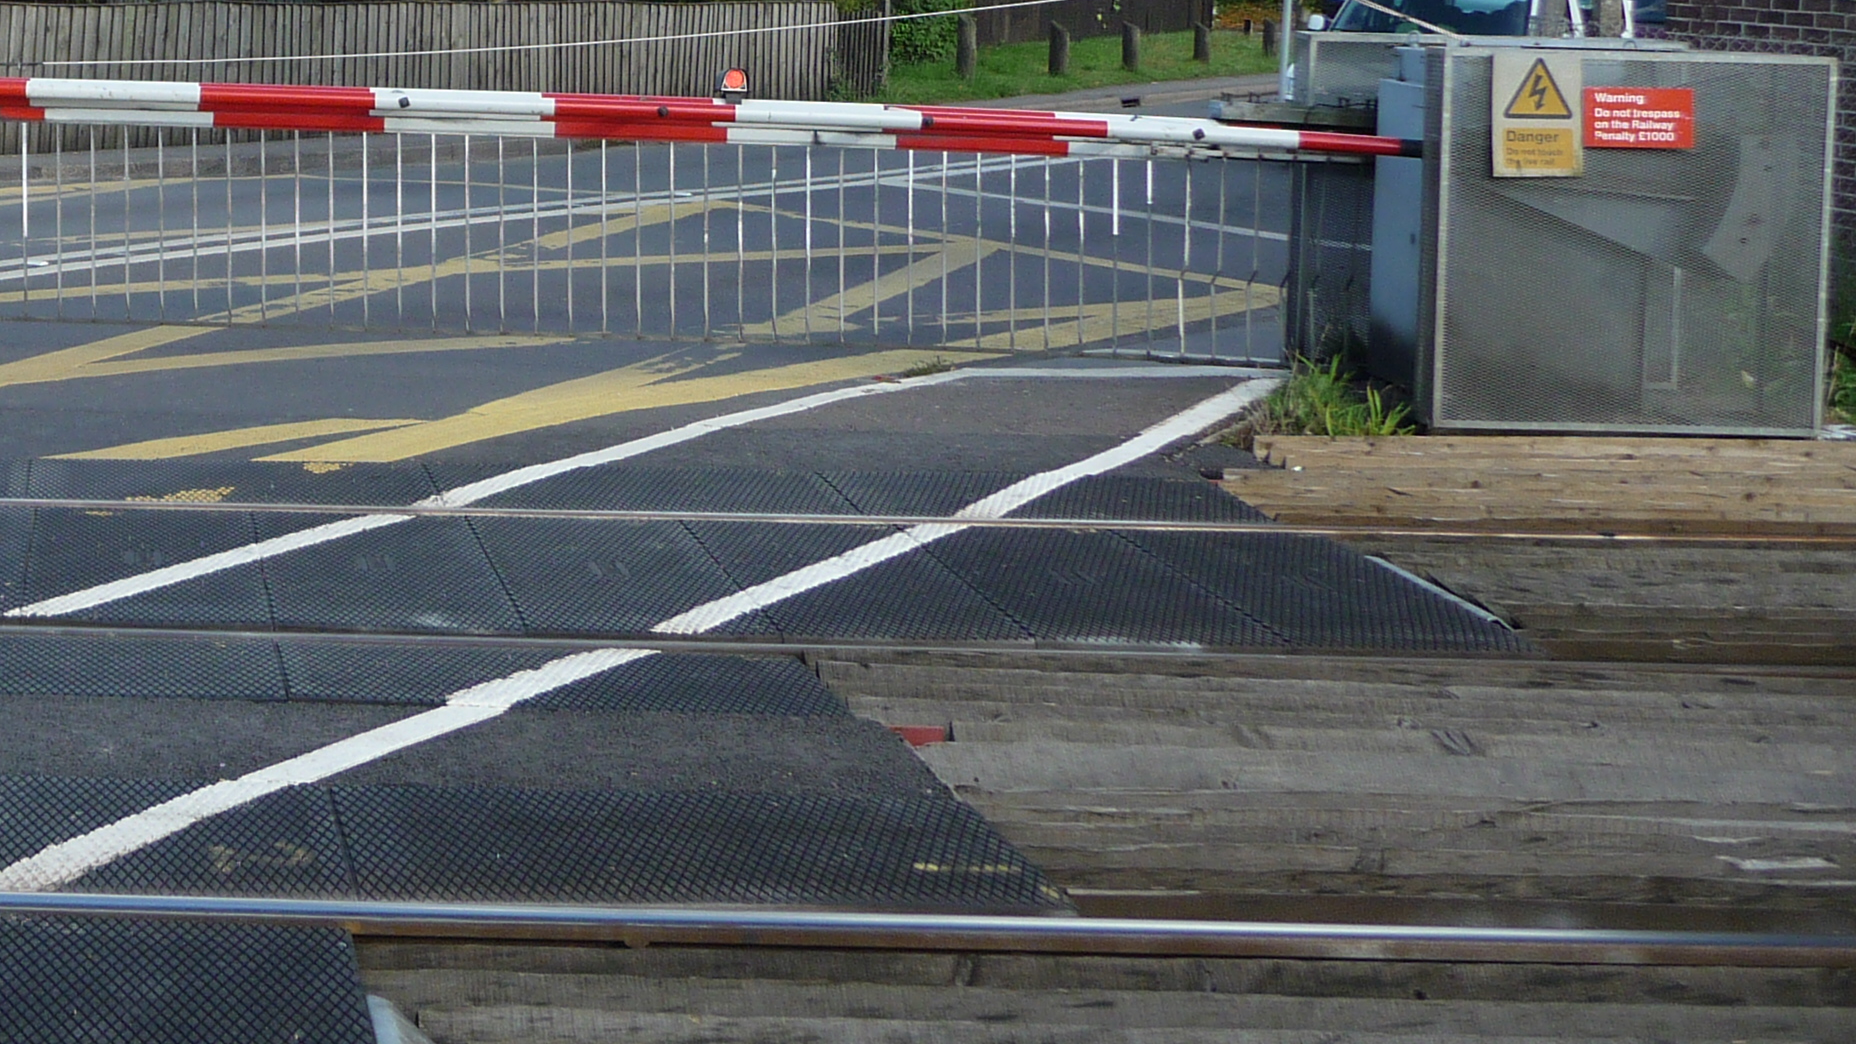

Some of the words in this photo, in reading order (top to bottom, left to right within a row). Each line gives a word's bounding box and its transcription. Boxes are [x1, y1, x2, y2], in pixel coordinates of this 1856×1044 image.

[1594, 92, 1645, 105] Warning
[1594, 107, 1611, 118] Do
[1612, 108, 1631, 118] not
[1633, 108, 1681, 120] trespass
[1594, 121, 1609, 129] on
[1611, 120, 1630, 129] the
[1631, 120, 1674, 131] Railway
[1506, 130, 1560, 144] Danger
[1594, 130, 1635, 143] Penalty
[1638, 131, 1675, 142] £1000
[1506, 147, 1519, 156] Do
[1521, 148, 1536, 156] not
[1538, 148, 1563, 156] touch
